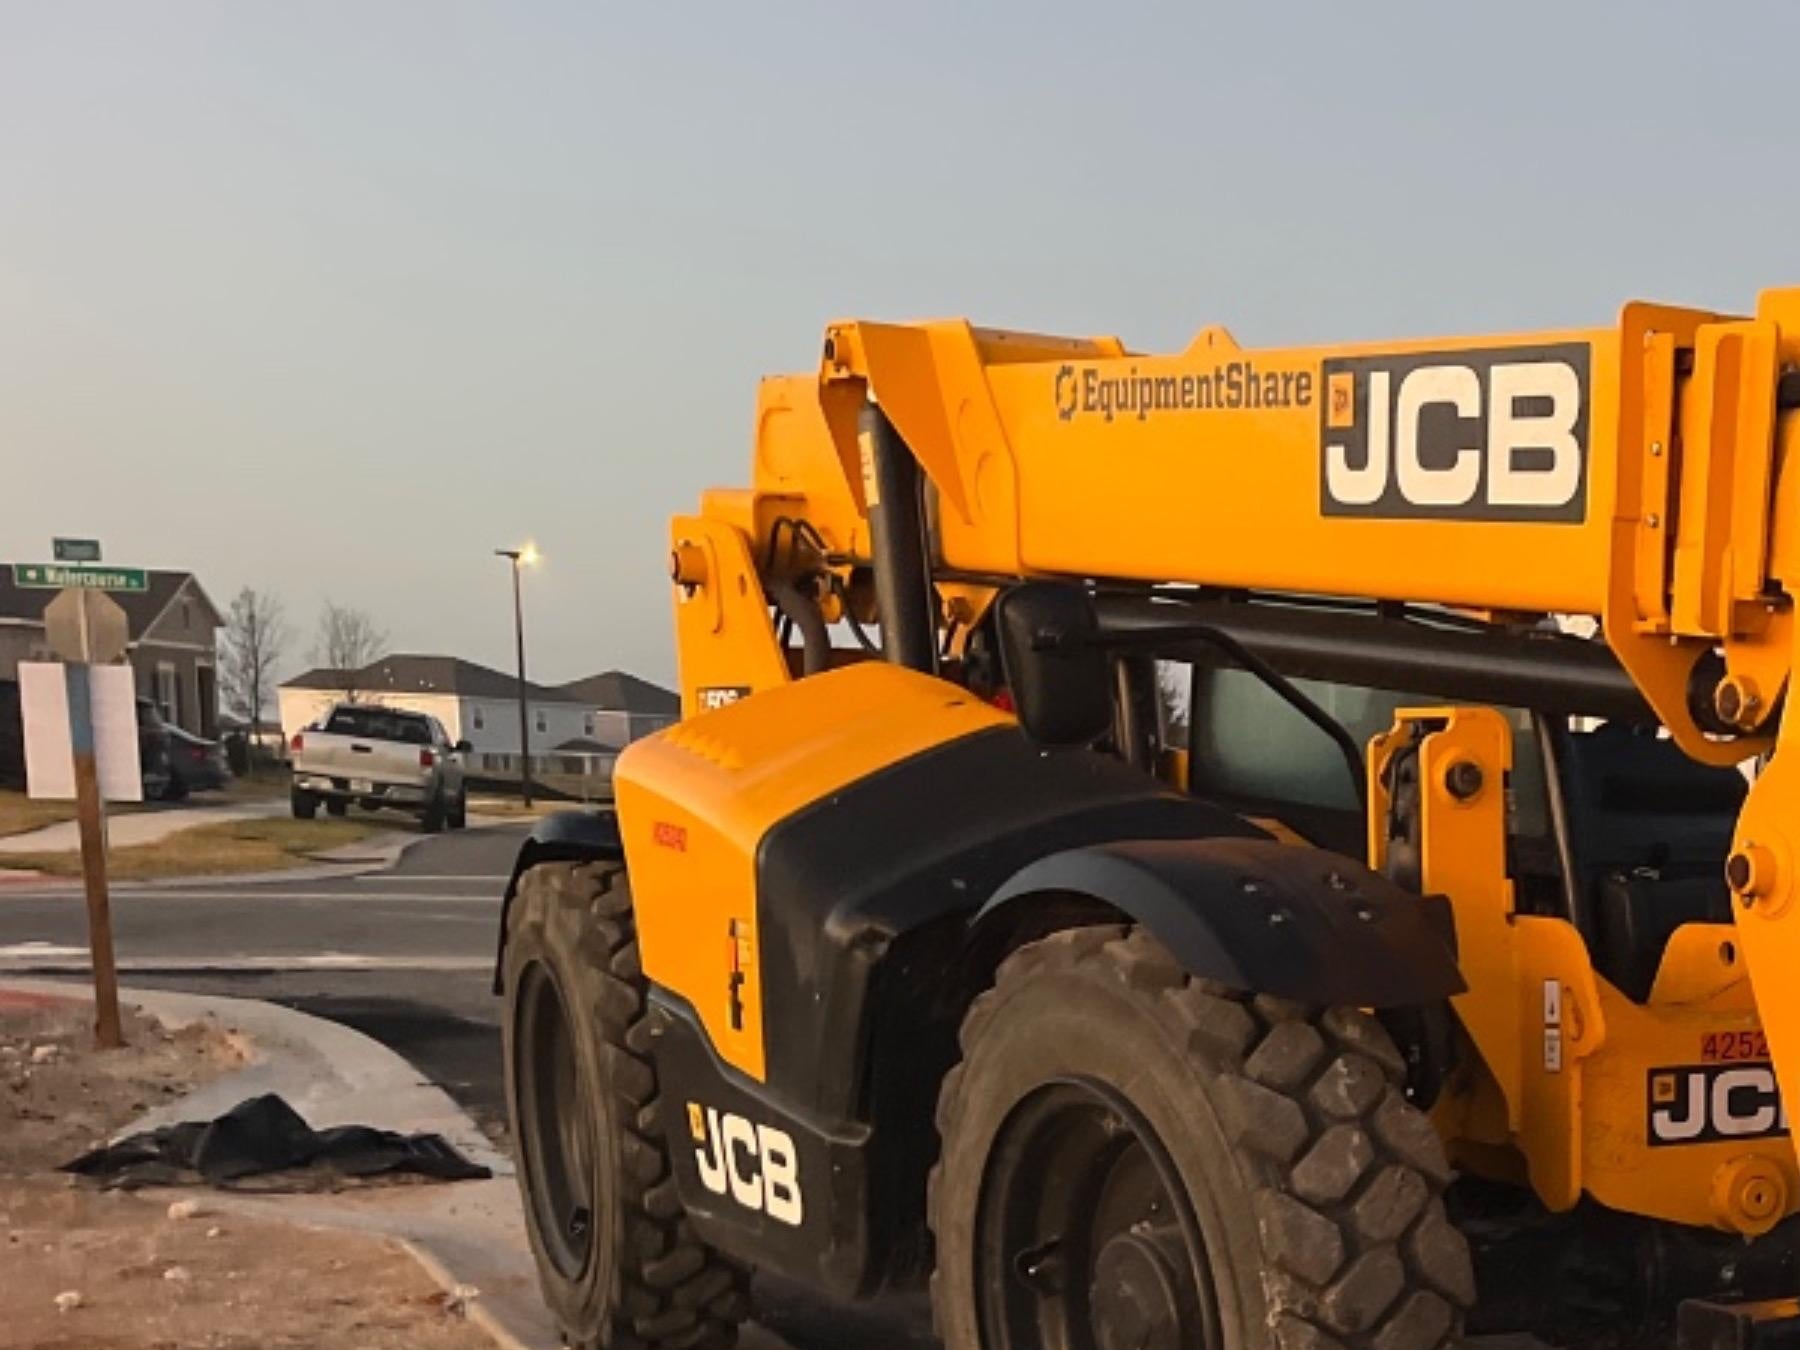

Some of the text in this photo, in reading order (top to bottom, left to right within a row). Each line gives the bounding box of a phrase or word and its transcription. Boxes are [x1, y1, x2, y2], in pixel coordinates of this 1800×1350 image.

[1081, 361, 1313, 423] EquipmentShare
[1325, 361, 1581, 506] JCB
[1652, 1067, 1791, 1140] JC
[694, 1105, 803, 1226] JCB
